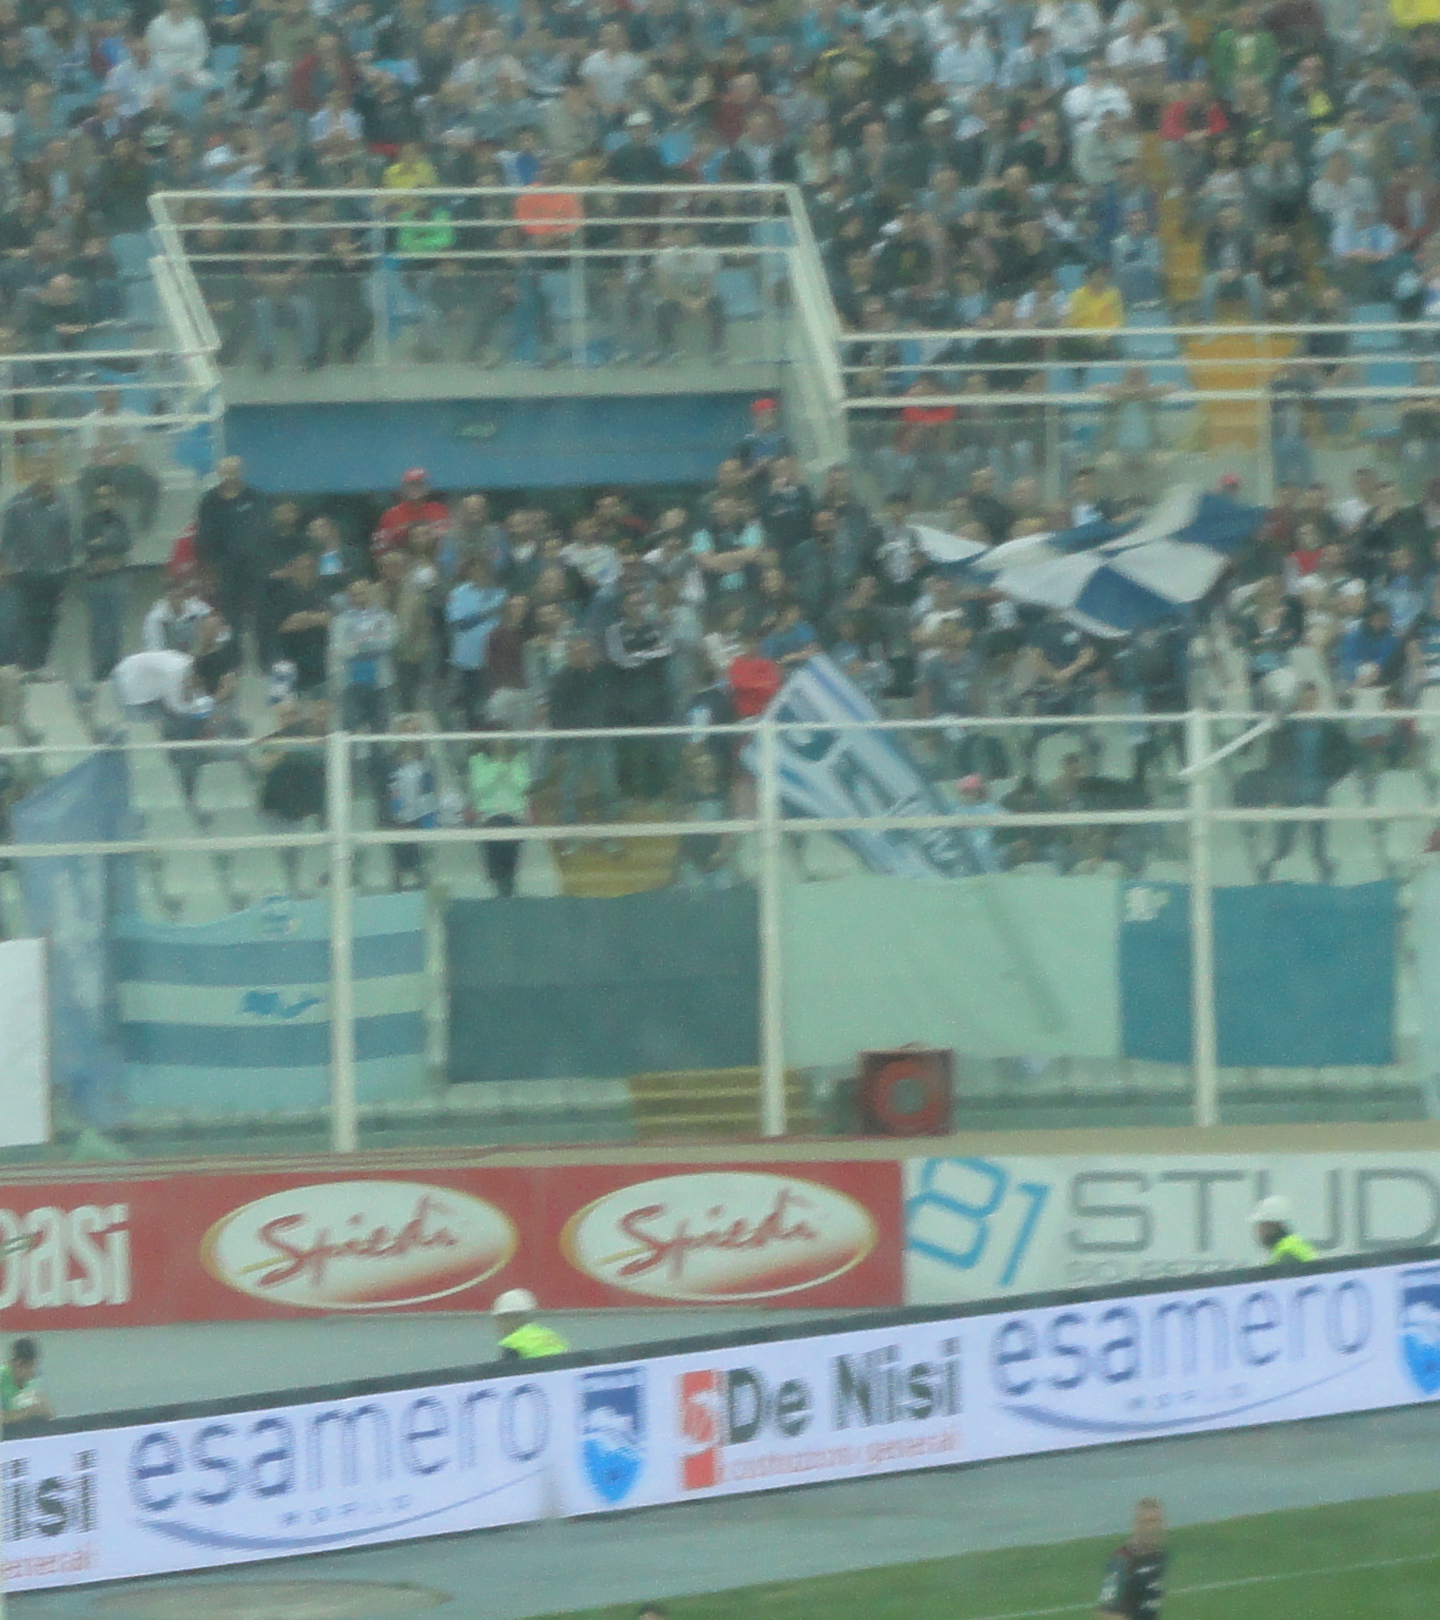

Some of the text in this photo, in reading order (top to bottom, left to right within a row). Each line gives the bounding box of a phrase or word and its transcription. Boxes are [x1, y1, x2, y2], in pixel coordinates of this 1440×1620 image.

[726, 1334, 963, 1444] De Nisi
[990, 1279, 1372, 1396] esamero
[128, 1383, 550, 1512] esamero
